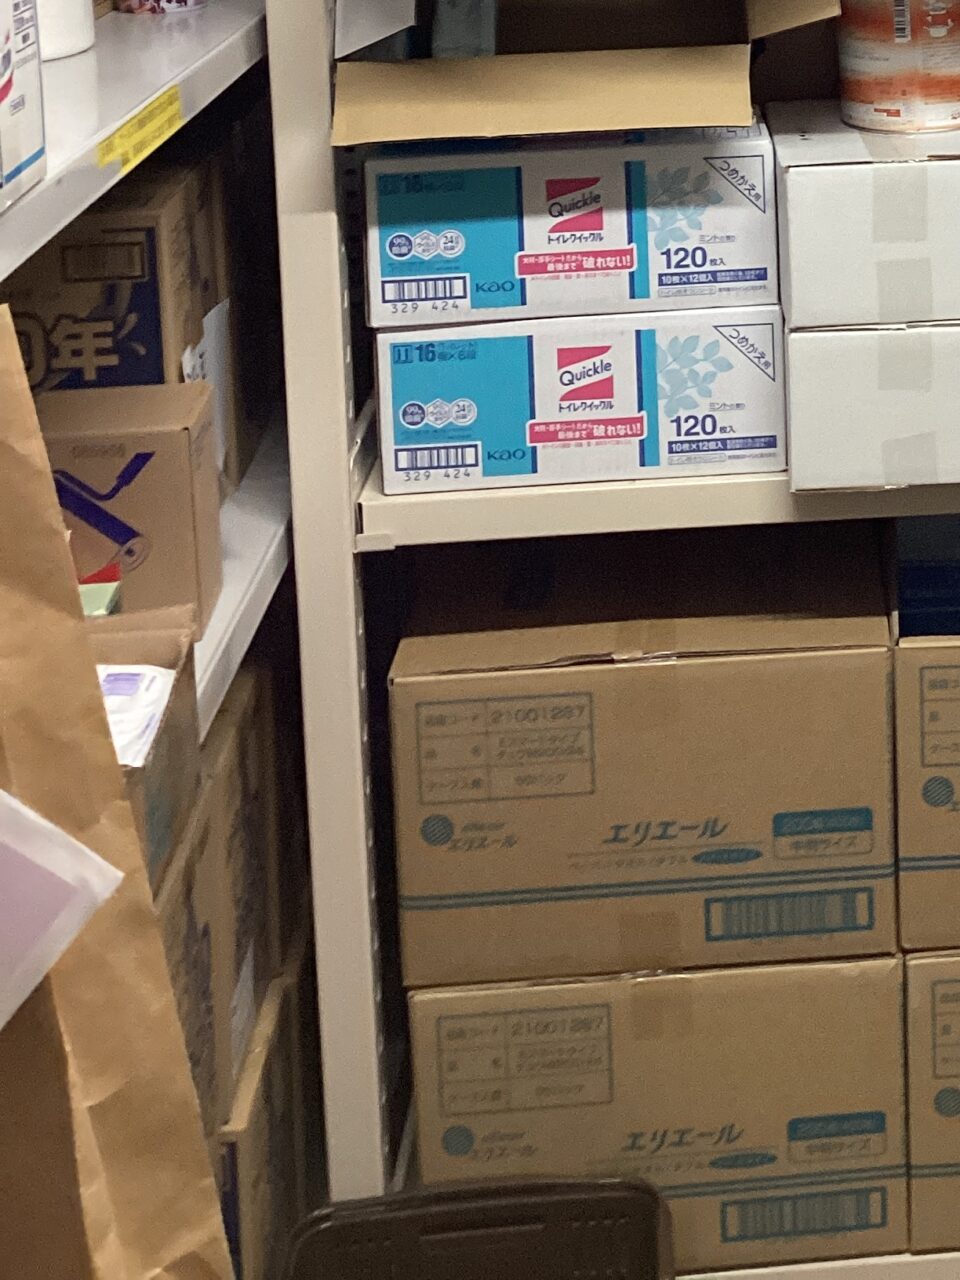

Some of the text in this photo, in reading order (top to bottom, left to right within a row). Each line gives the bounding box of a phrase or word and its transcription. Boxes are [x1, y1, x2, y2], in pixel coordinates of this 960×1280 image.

[719, 160, 763, 202] つめかえ用
[548, 191, 602, 218] Quickle
[547, 232, 604, 245] トイレクイックル
[660, 246, 707, 269] 120
[391, 300, 460, 314] 329 424
[728, 328, 772, 370] つめかえ用
[559, 359, 612, 386] Quickle
[558, 400, 614, 413] トイレクイックル
[670, 413, 717, 437] 120
[403, 469, 471, 482] 329 424
[603, 816, 729, 847] エリエール
[620, 1123, 744, 1153] エリエール
